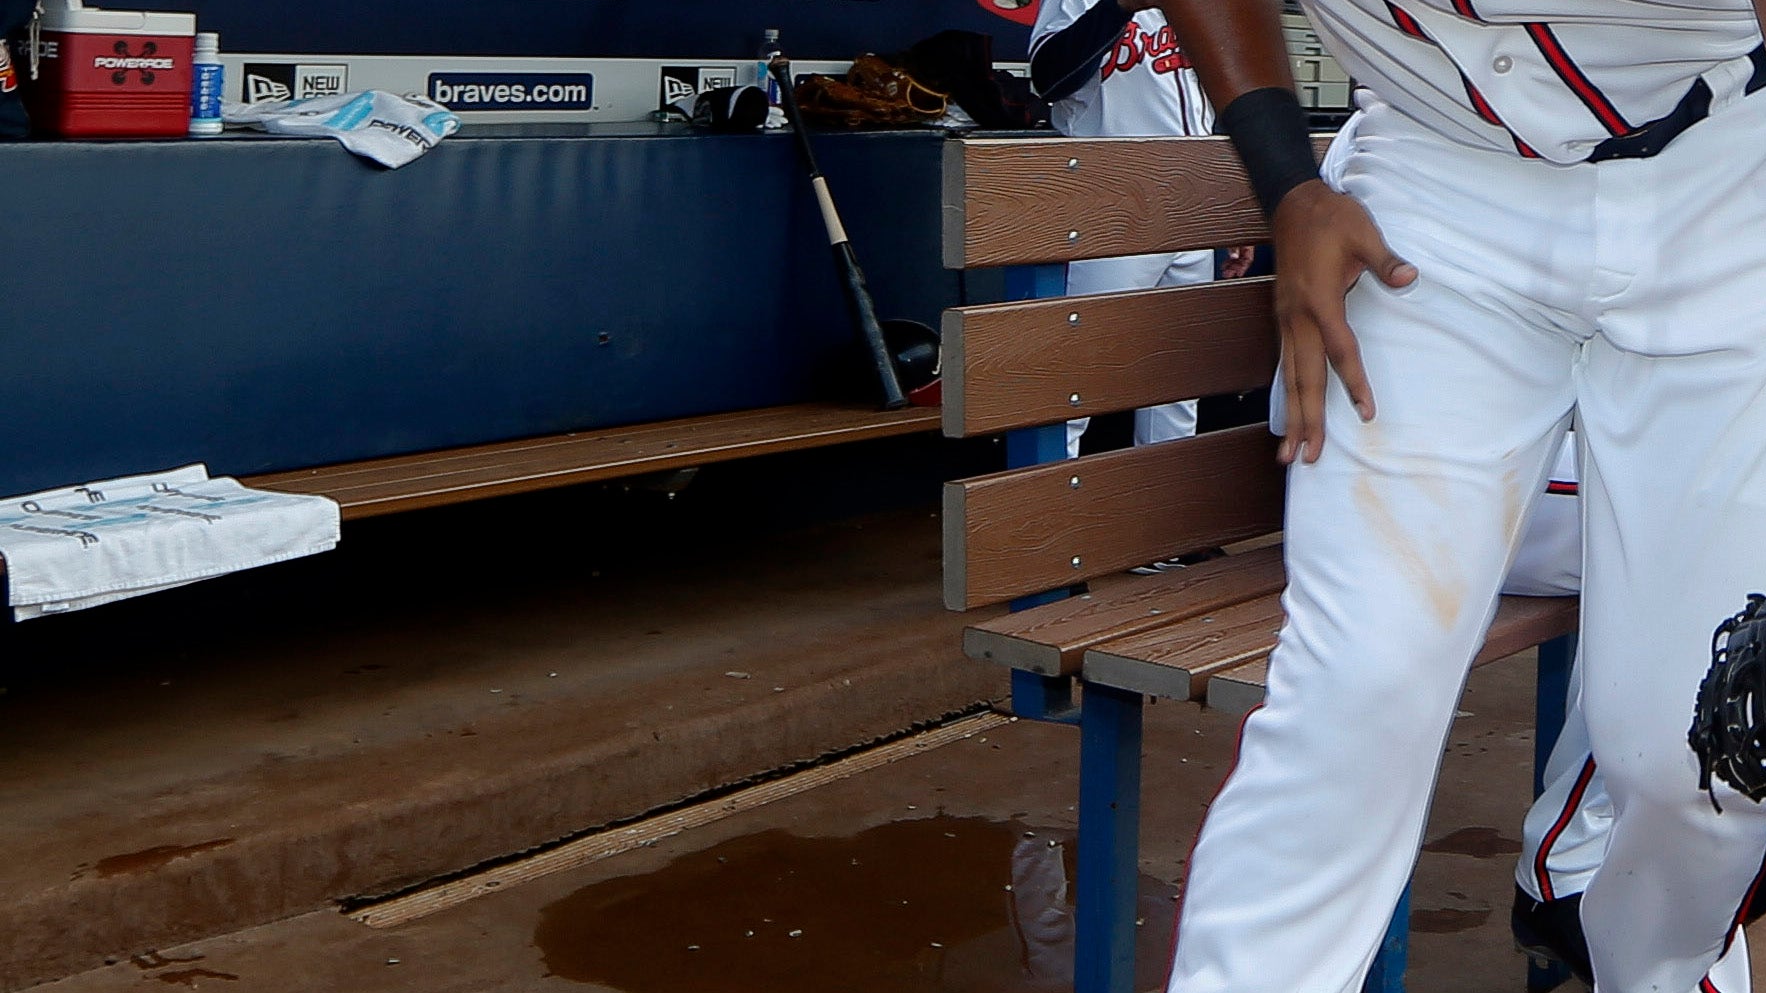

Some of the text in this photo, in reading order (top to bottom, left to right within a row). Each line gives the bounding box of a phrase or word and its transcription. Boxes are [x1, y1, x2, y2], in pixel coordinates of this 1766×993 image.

[1100, 20, 1181, 83] Bra
[94, 56, 176, 70] POWERADE
[303, 75, 340, 92] NEW
[434, 78, 588, 104] braves.com
